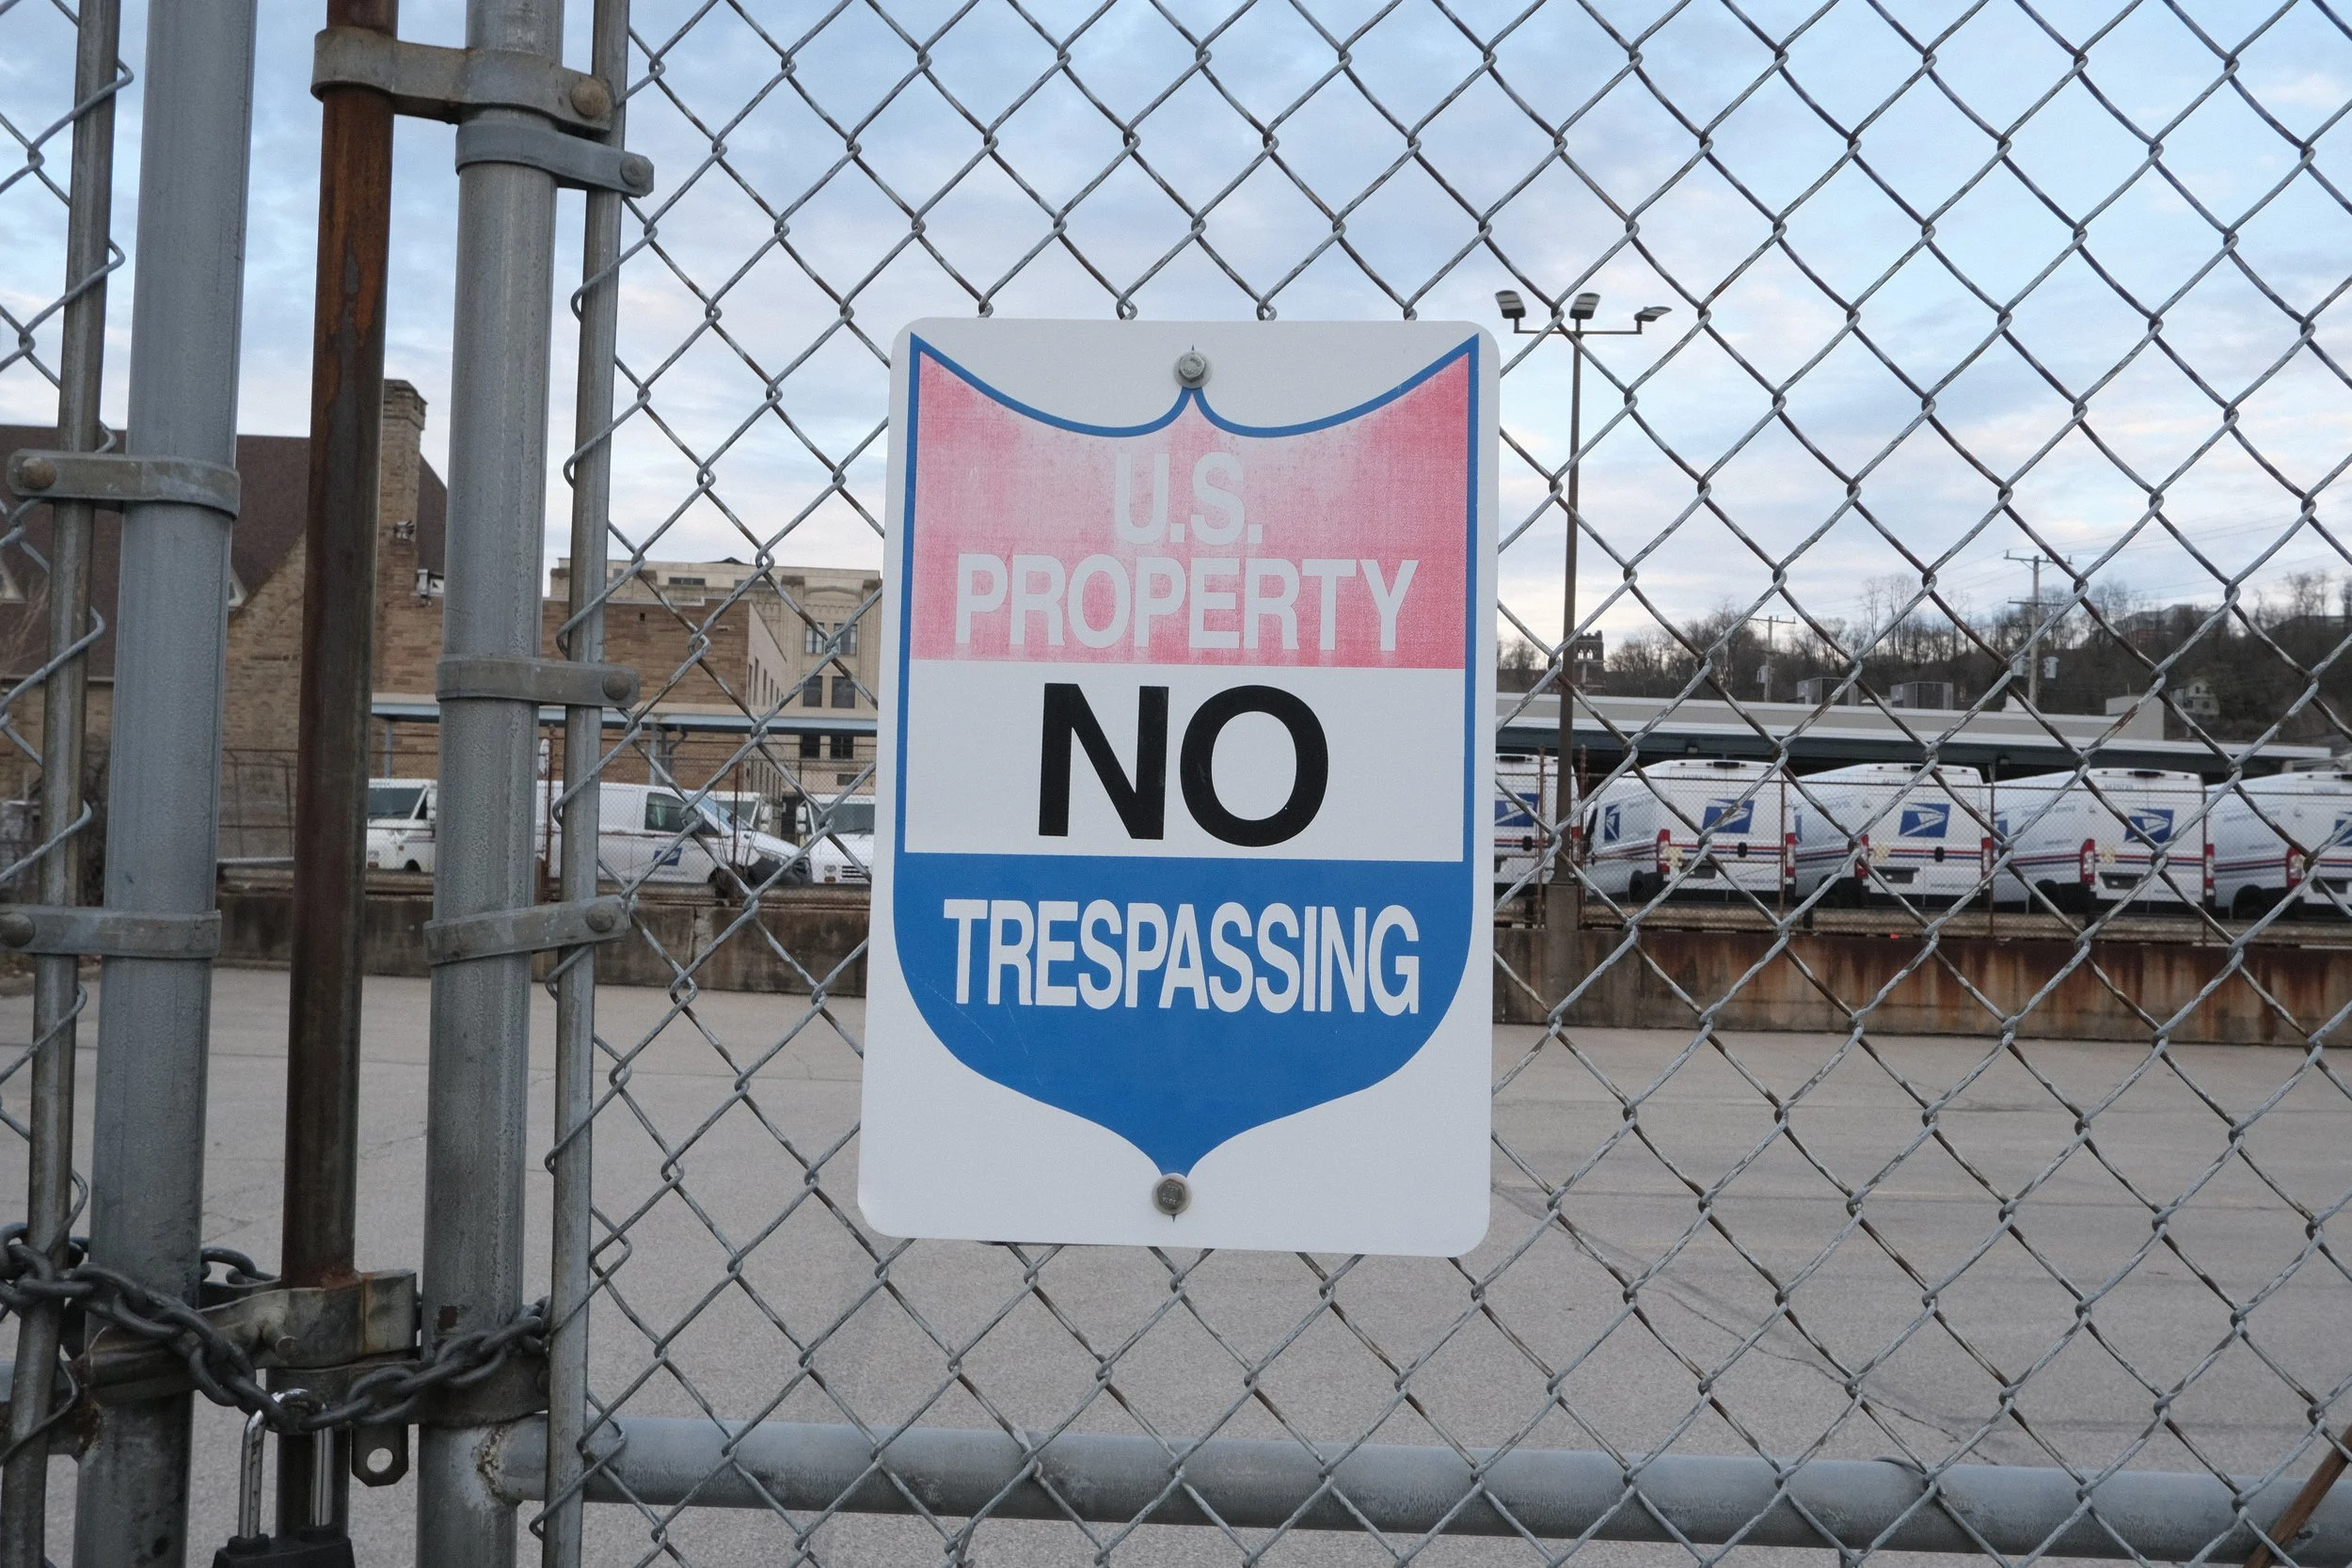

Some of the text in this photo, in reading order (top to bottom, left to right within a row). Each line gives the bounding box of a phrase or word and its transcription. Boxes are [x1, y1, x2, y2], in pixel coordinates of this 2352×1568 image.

[1113, 451, 1263, 546] U.S.
[955, 553, 1419, 652] PROPERTY
[1039, 682, 1328, 847] NO
[943, 898, 1421, 1015] TRESPASSING
